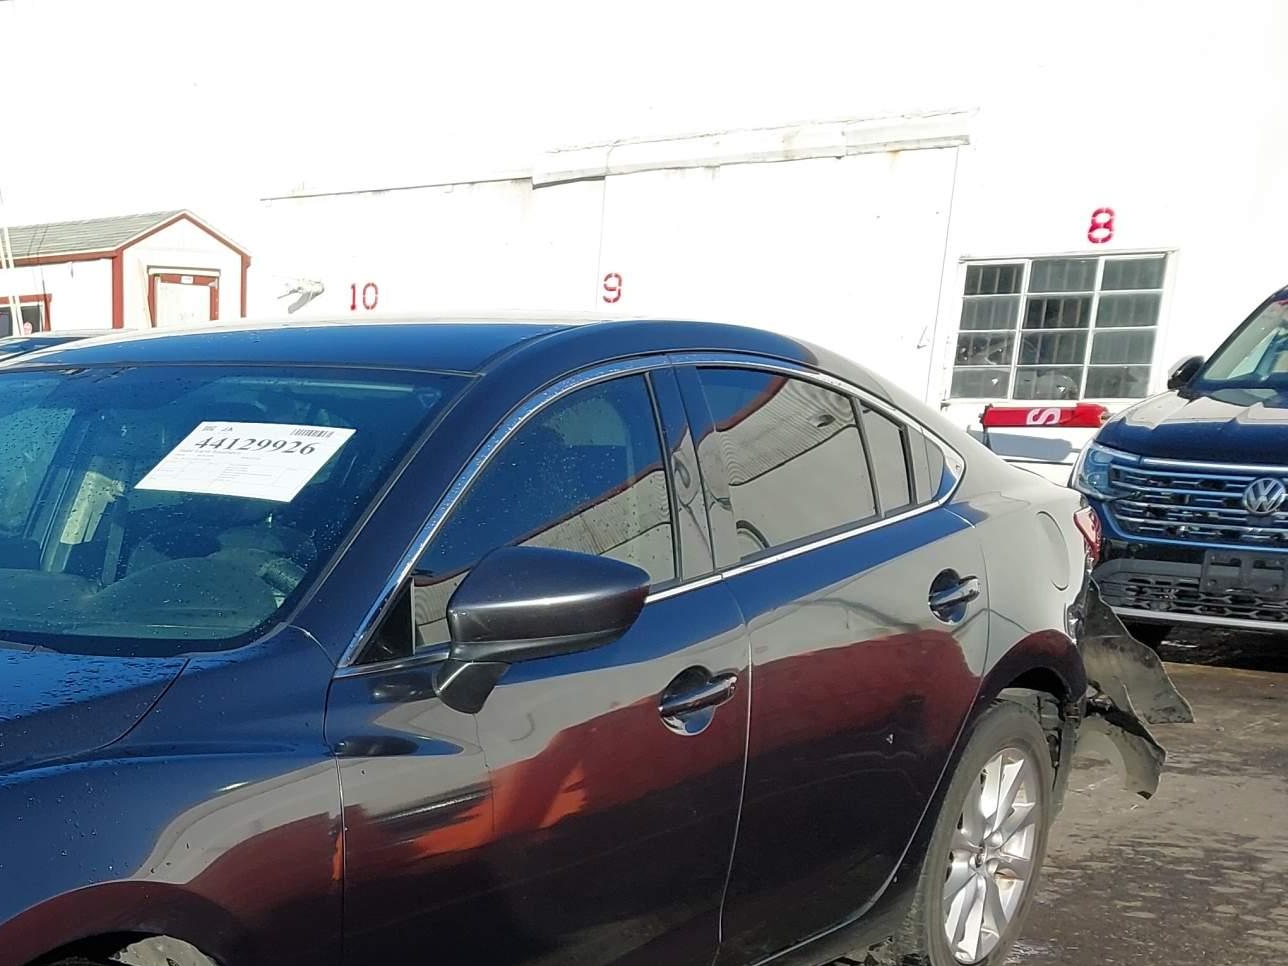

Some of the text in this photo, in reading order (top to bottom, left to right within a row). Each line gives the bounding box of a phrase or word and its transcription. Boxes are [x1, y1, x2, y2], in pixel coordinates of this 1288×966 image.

[1087, 207, 1115, 244] 8
[350, 282, 379, 310] 10
[603, 272, 622, 304] 9
[194, 436, 320, 456] 44129926
